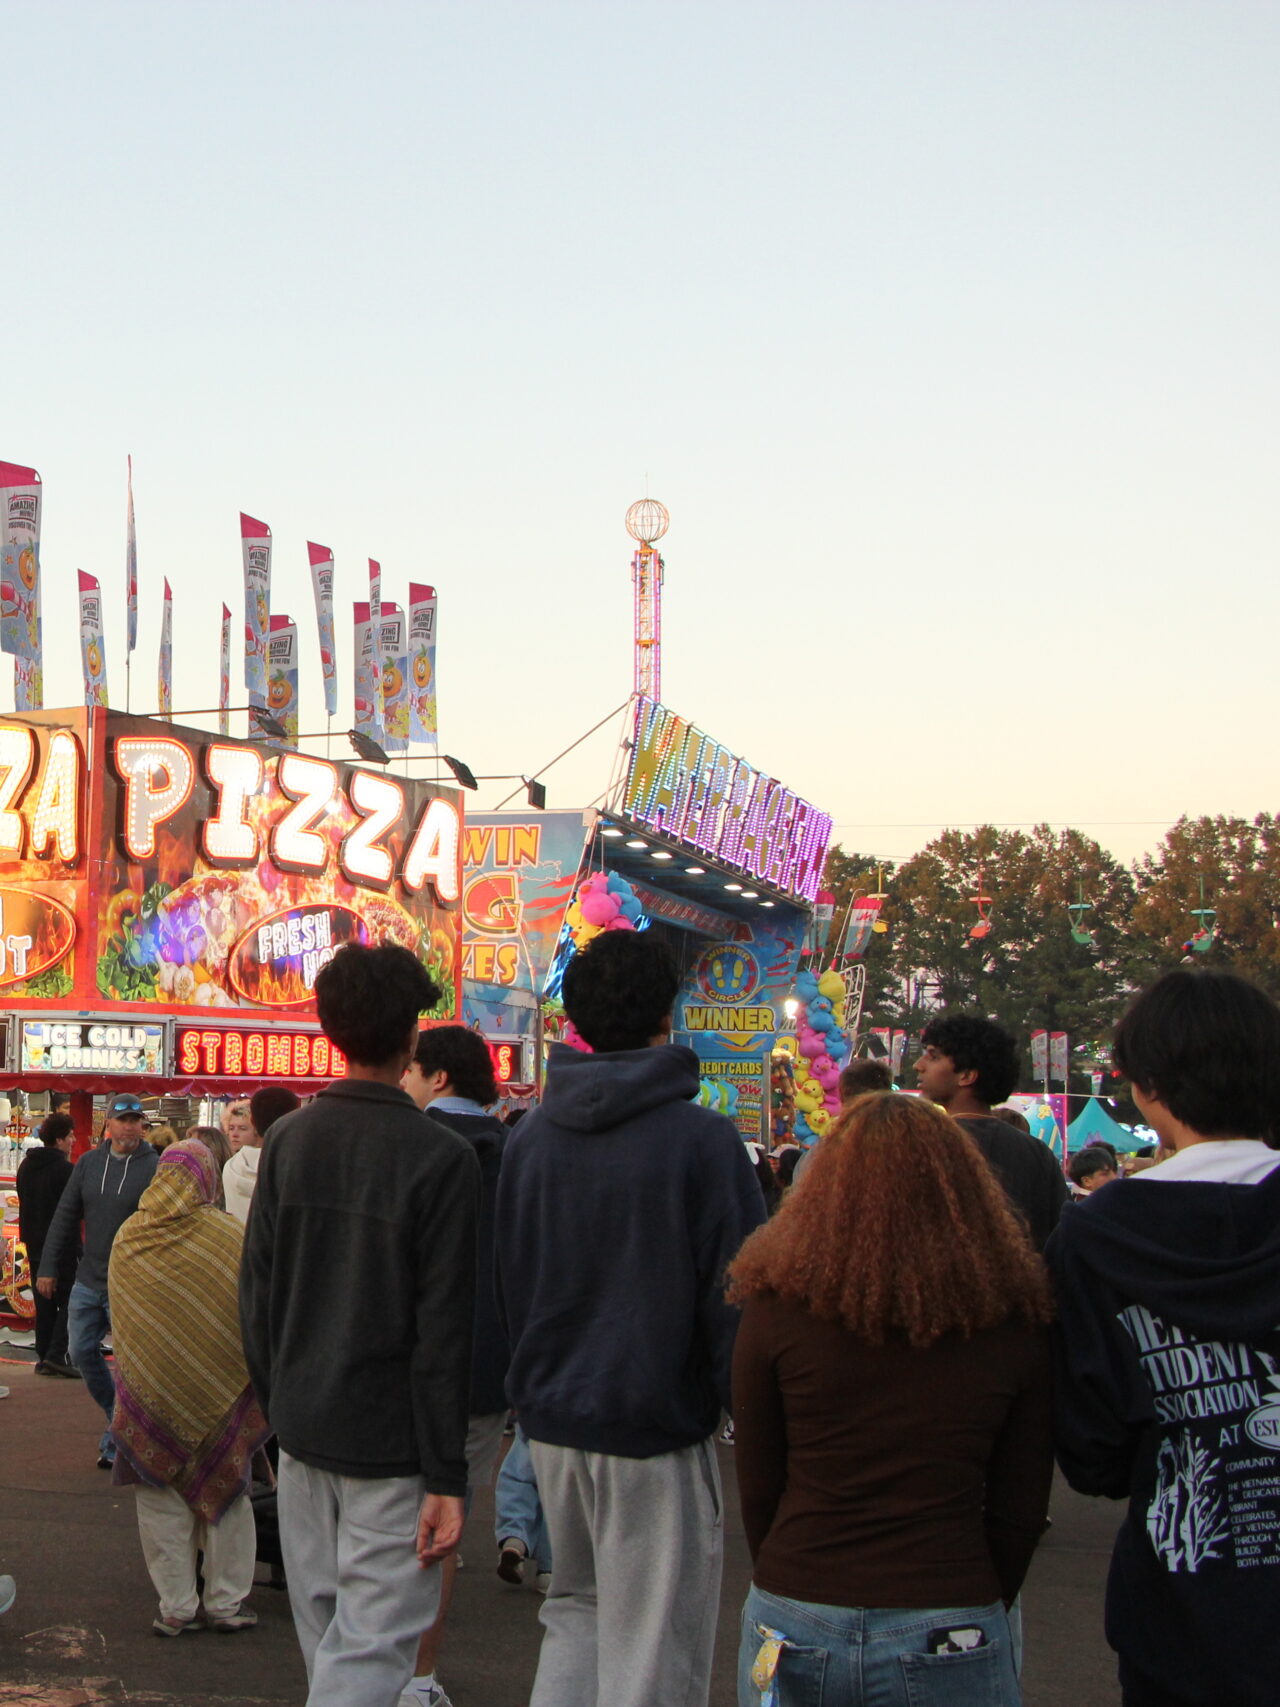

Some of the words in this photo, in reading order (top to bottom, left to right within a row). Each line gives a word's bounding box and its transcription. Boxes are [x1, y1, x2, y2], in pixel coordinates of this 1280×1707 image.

[624, 695, 733, 853] WATER
[114, 736, 461, 902] PIZZA
[465, 824, 538, 867] WIN
[257, 910, 332, 965] FRESH
[706, 944, 751, 962] WINNER
[302, 945, 342, 990] HO
[707, 987, 749, 1004] CIRCLE
[684, 1006, 775, 1031] WINNER
[41, 1023, 82, 1048] ICE
[88, 1025, 147, 1049] COLD
[50, 1047, 140, 1071] DRINKS
[180, 1030, 347, 1077] STROMBOL
[700, 1062, 728, 1075] REDIT
[729, 1062, 762, 1075] CARDS
[5, 1125, 31, 1135] PIZZA
[1139, 1341, 1251, 1392] TUDENT
[1154, 1379, 1260, 1425] SSOCIATION
[1219, 1424, 1241, 1448] AT
[1225, 1457, 1275, 1473] COMMUNITY
[1228, 1481, 1239, 1491] THE
[1241, 1476, 1280, 1489] VIETNAME
[1242, 1487, 1280, 1500] DEDICATE
[1229, 1501, 1258, 1513] VIBRANT
[1230, 1510, 1276, 1525] CELEBRATES
[1232, 1525, 1241, 1535] OF
[1245, 1521, 1280, 1532] VIETNAM
[1234, 1533, 1272, 1546] THROUGH
[1235, 1545, 1261, 1557] BUILDS
[1237, 1557, 1260, 1568] BOTH
[1262, 1555, 1280, 1566] WITH
